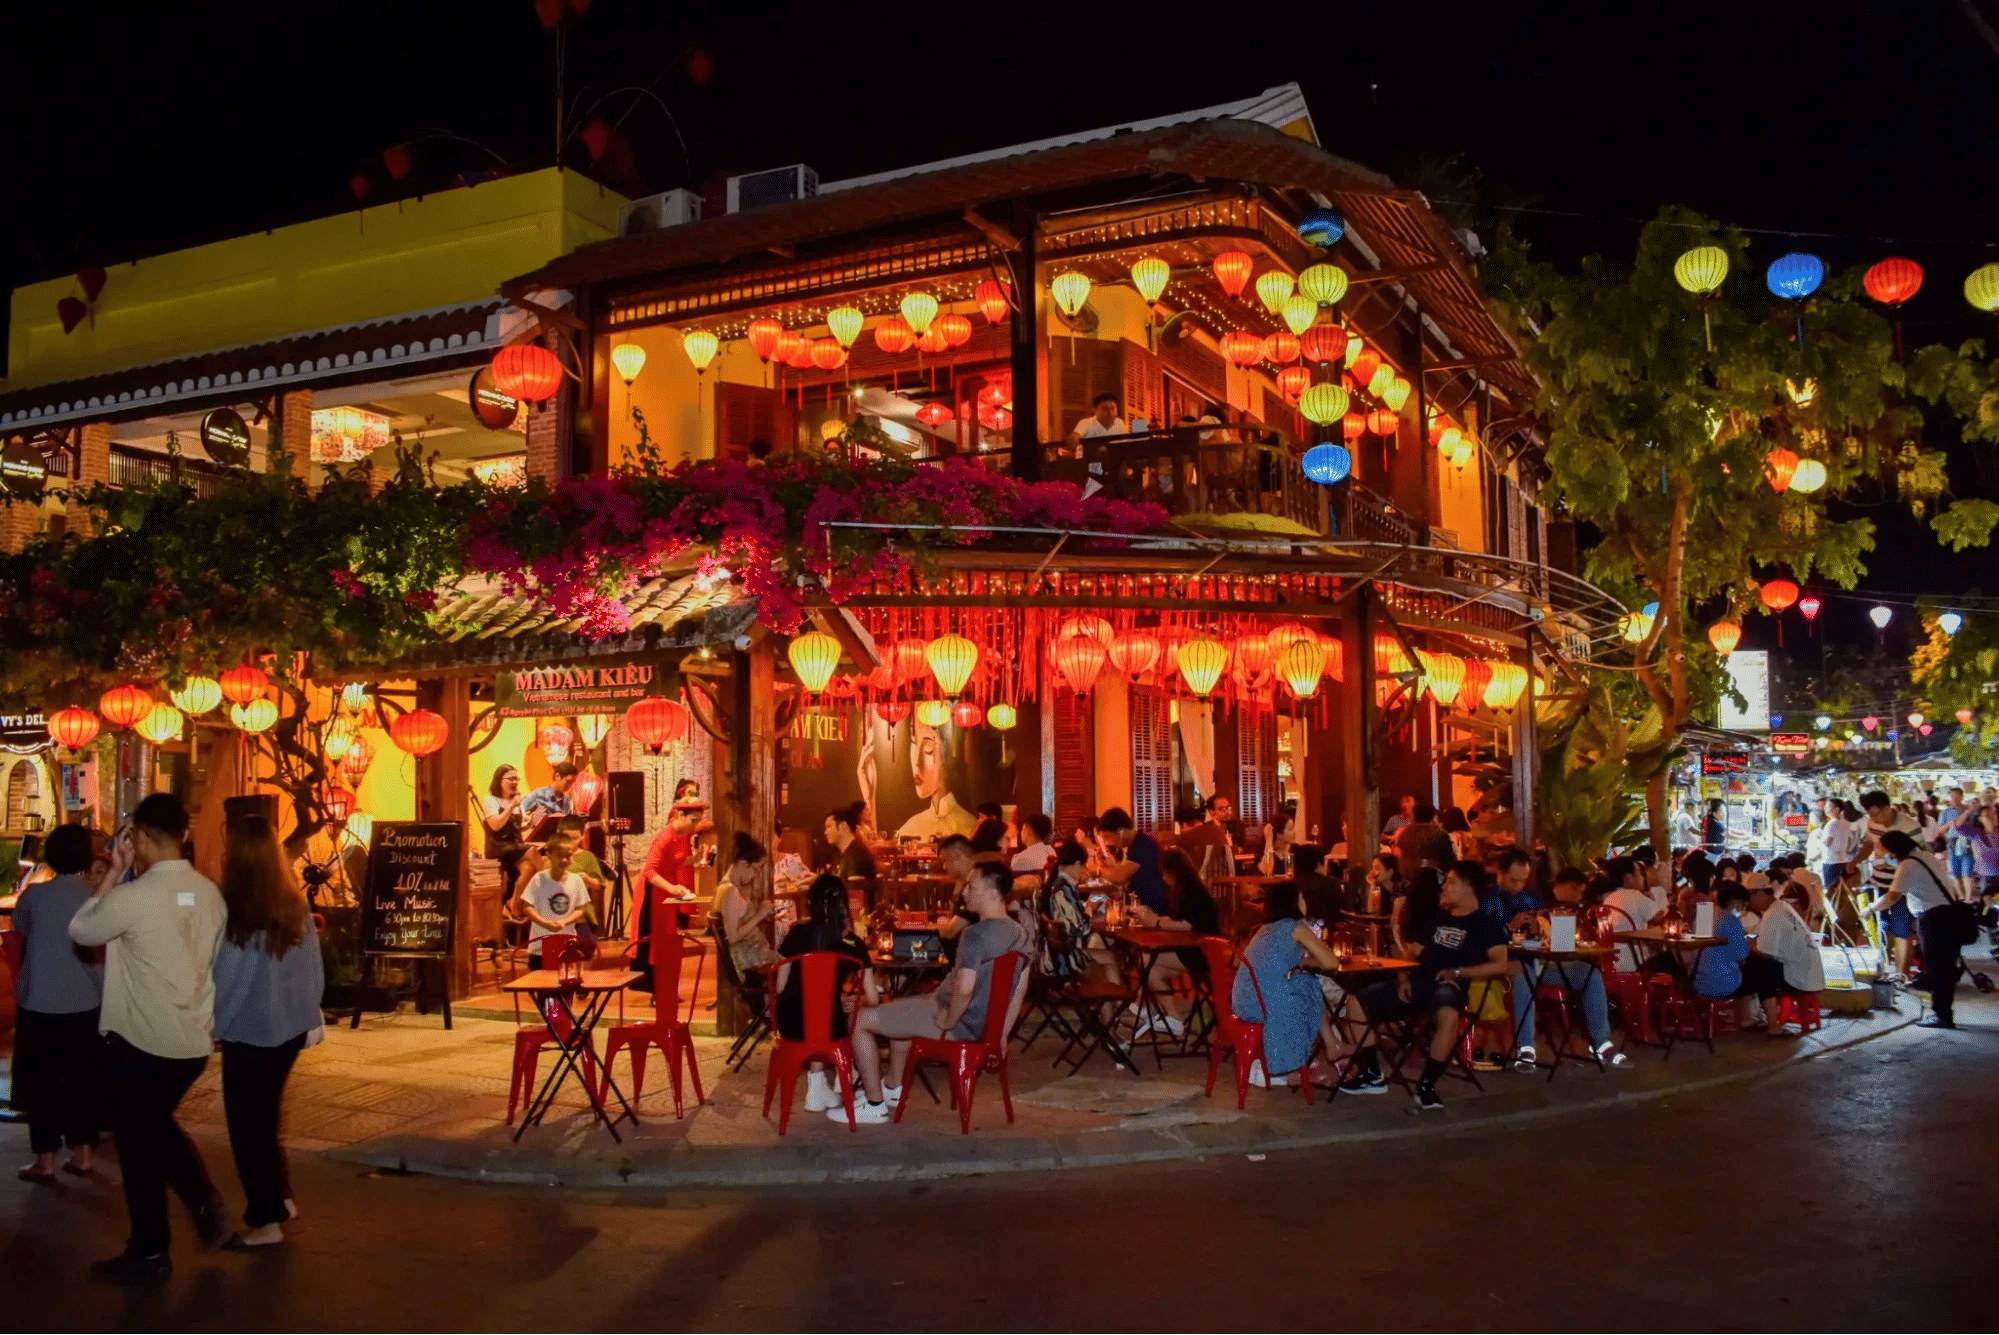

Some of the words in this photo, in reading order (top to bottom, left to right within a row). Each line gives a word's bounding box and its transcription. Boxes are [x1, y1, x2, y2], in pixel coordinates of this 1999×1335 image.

[515, 668, 595, 691] MADAM
[524, 692, 569, 703] Vietnamese
[570, 689, 612, 700] restaurant
[613, 689, 629, 698] and
[631, 688, 645, 697] bar
[380, 827, 448, 847] Promotion
[388, 851, 438, 866] Discount
[393, 871, 424, 893] 10%
[375, 895, 396, 910] Live
[404, 894, 437, 910] Music
